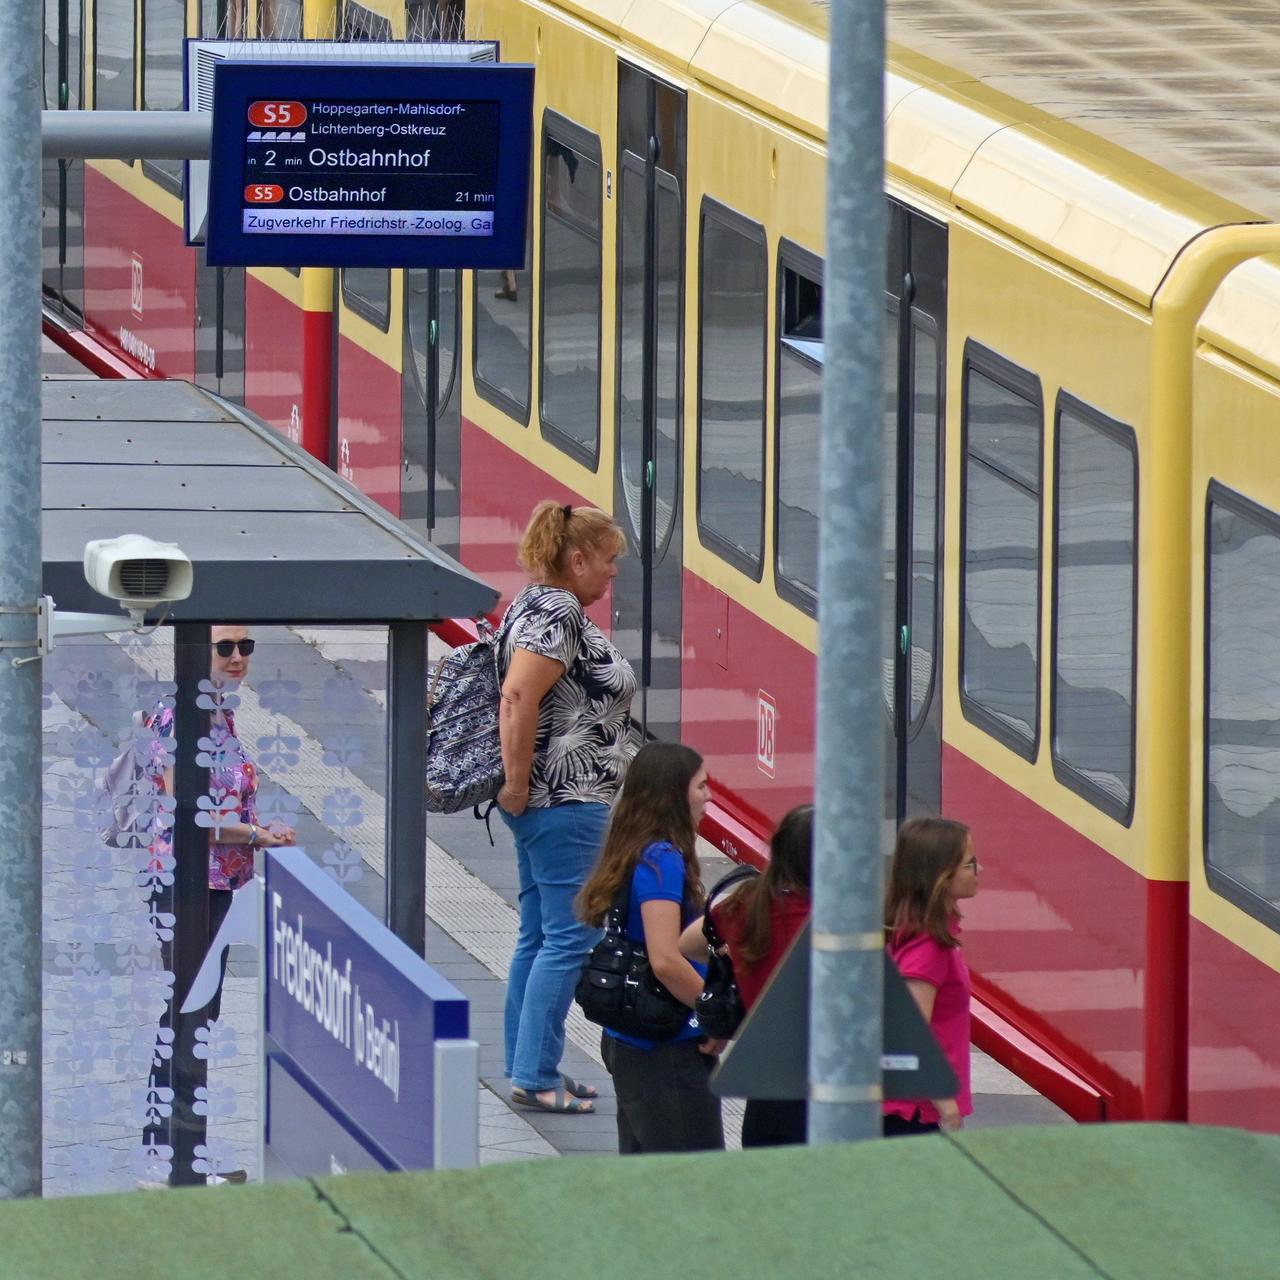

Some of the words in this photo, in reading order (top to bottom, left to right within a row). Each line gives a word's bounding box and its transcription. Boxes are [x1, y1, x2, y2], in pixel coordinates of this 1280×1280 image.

[263, 104, 291, 124] S5
[312, 103, 466, 117] Hoppegarten-Mahlsdorf-
[311, 123, 446, 137] Lichtenberg-Ostkreuz
[247, 157, 257, 165] in
[264, 150, 276, 166] 2
[284, 157, 302, 166] min
[308, 148, 431, 167] Ostbahnhof
[254, 187, 273, 200] S5
[288, 187, 387, 202] Ostbahnhof
[455, 192, 470, 202] 21
[474, 192, 494, 203] min
[247, 216, 327, 231] Zugverkehr
[330, 217, 467, 232] Friedrichstr.-Zoolog.
[132, 261, 143, 312] DB
[759, 701, 774, 765] DB
[272, 891, 353, 1050] Fredersdorf
